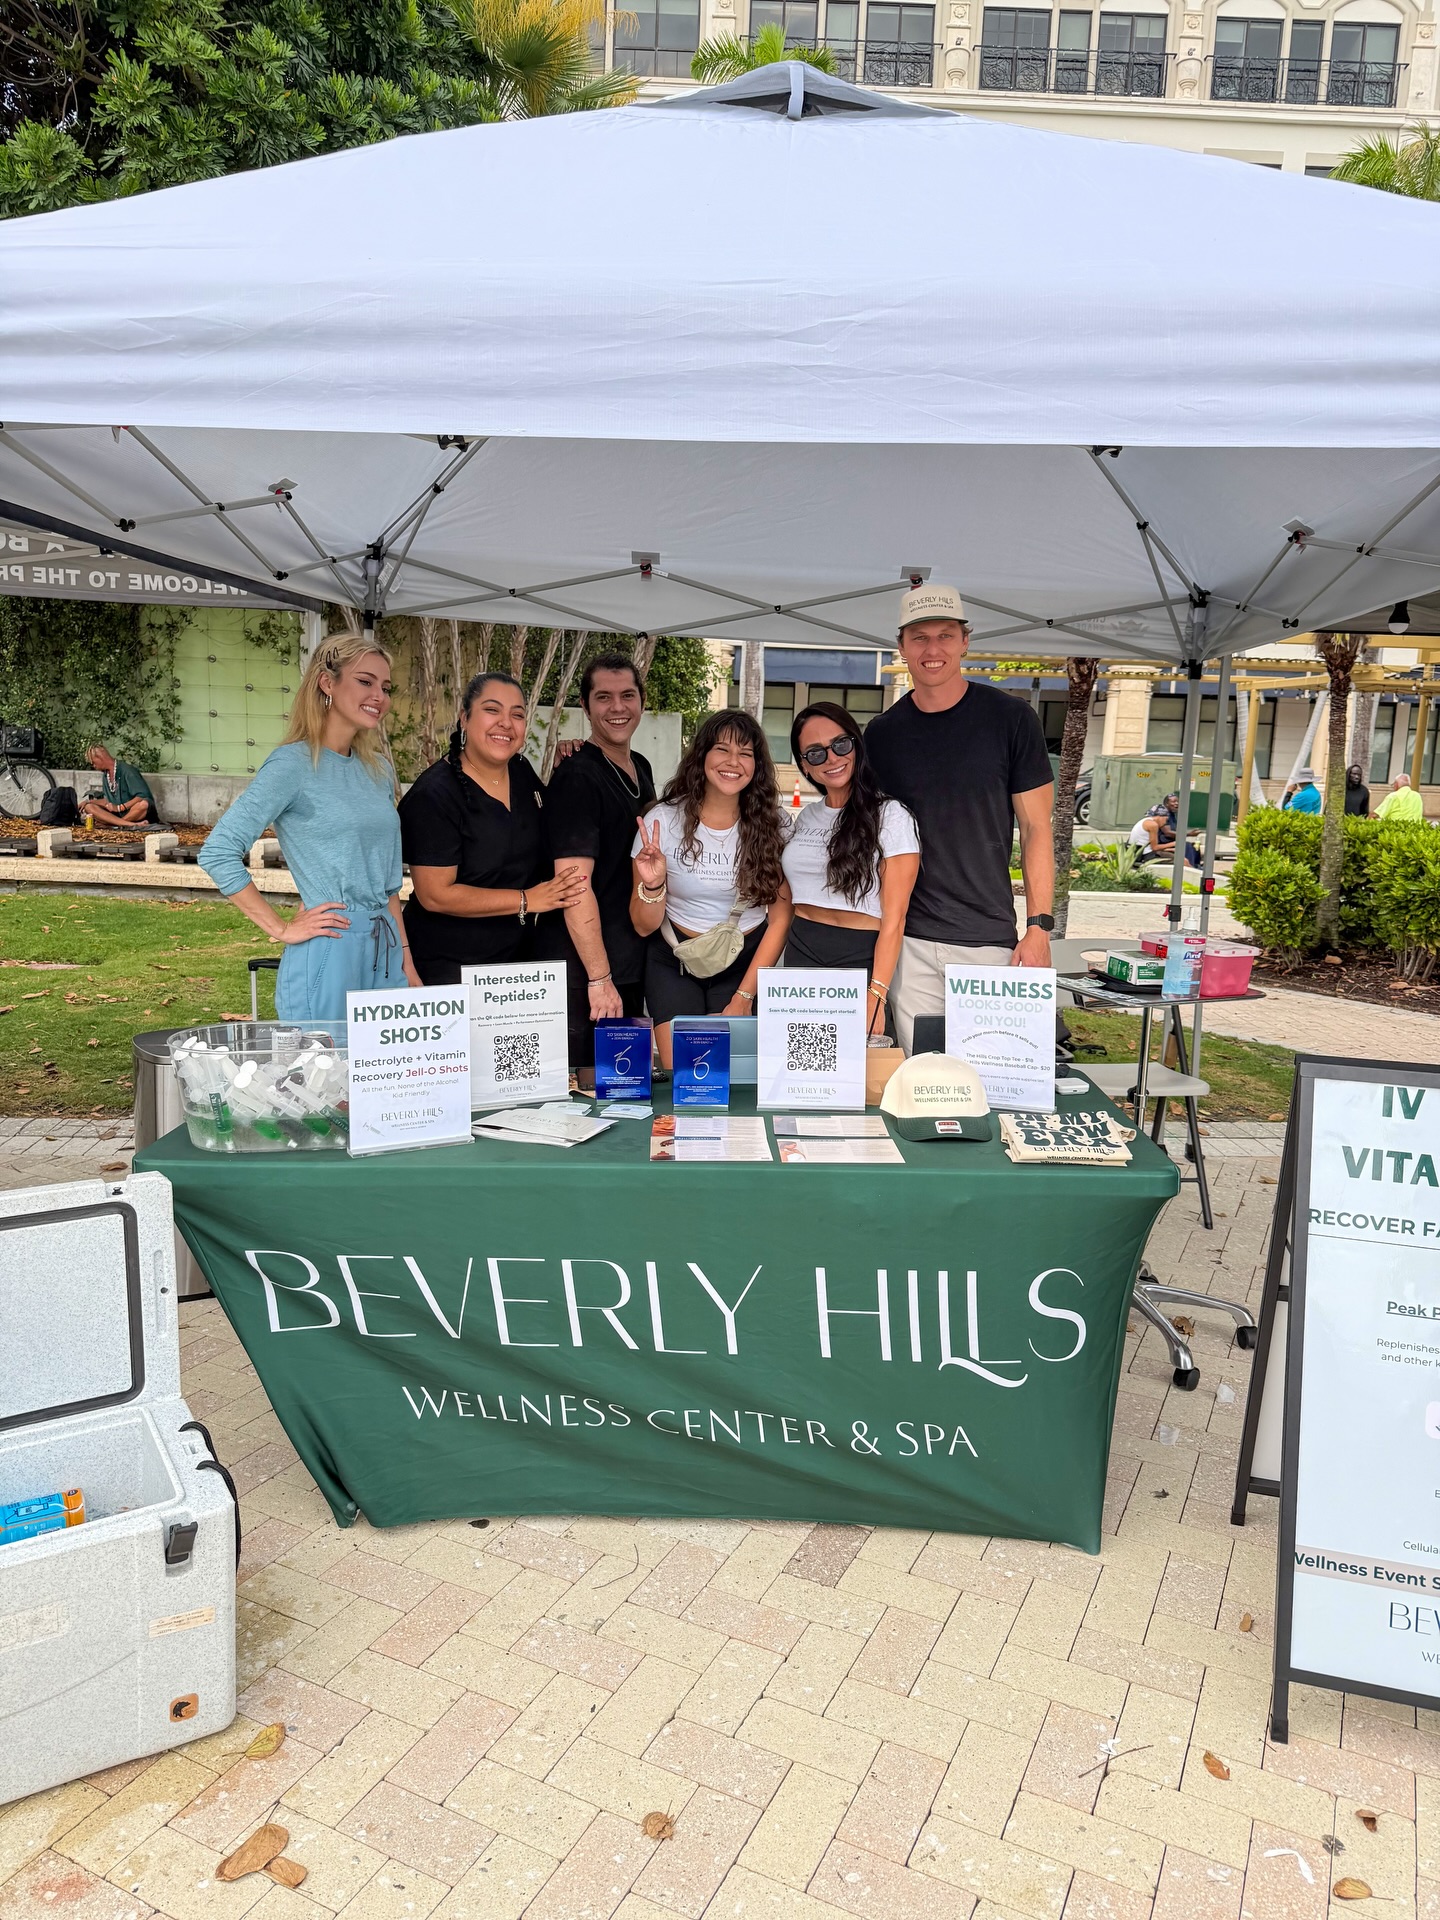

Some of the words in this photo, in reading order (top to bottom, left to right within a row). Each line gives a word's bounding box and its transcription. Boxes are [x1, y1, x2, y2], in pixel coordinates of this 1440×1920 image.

[673, 848, 731, 865] BEERLY
[473, 970, 541, 987] Interested
[544, 970, 556, 982] in
[483, 988, 547, 1005] Peptides?
[767, 986, 816, 998] INTAKE
[819, 987, 858, 999] FORM
[949, 977, 1053, 1000] WELLNESS
[353, 999, 465, 1023] HYDRATION
[958, 997, 1001, 1011] LOOKS
[1004, 1000, 1043, 1014] GOOD
[973, 1014, 994, 1026] ON
[995, 1015, 1026, 1029] YOU!
[379, 1025, 442, 1045] SHOTS
[353, 1053, 414, 1069] Electrolyte
[424, 1050, 466, 1062] Vitamin
[352, 1070, 403, 1083] Recovery
[405, 1065, 437, 1078] Jell-O
[439, 1063, 469, 1074] Shots
[404, 1090, 430, 1098] Friendly
[787, 1086, 818, 1094] BEVERLY
[914, 1085, 951, 1095] BEVERLY
[953, 1085, 971, 1096] HILLS
[984, 1085, 1006, 1093] VERLY
[1382, 1085, 1426, 1120] IV
[381, 1109, 420, 1121] BEVERLY
[422, 1106, 444, 1117] HILLS
[1021, 1128, 1122, 1148] ERA
[1341, 1145, 1440, 1188] VITA
[1308, 1208, 1416, 1236] RECOVER
[1423, 1221, 1440, 1239] F
[1387, 1300, 1427, 1317] Peak
[244, 1250, 763, 1355] BEVERLY
[815, 1267, 1087, 1388] HILLS
[1376, 1337, 1440, 1355] Replenishes
[1381, 1353, 1401, 1363] and
[1404, 1356, 1432, 1367] other
[401, 1386, 631, 1428] WELLNESS
[646, 1408, 836, 1448] CENTER
[850, 1420, 882, 1456] &
[895, 1421, 979, 1458] SPA
[1403, 1540, 1440, 1555] Cellula
[1373, 1565, 1427, 1588] Event
